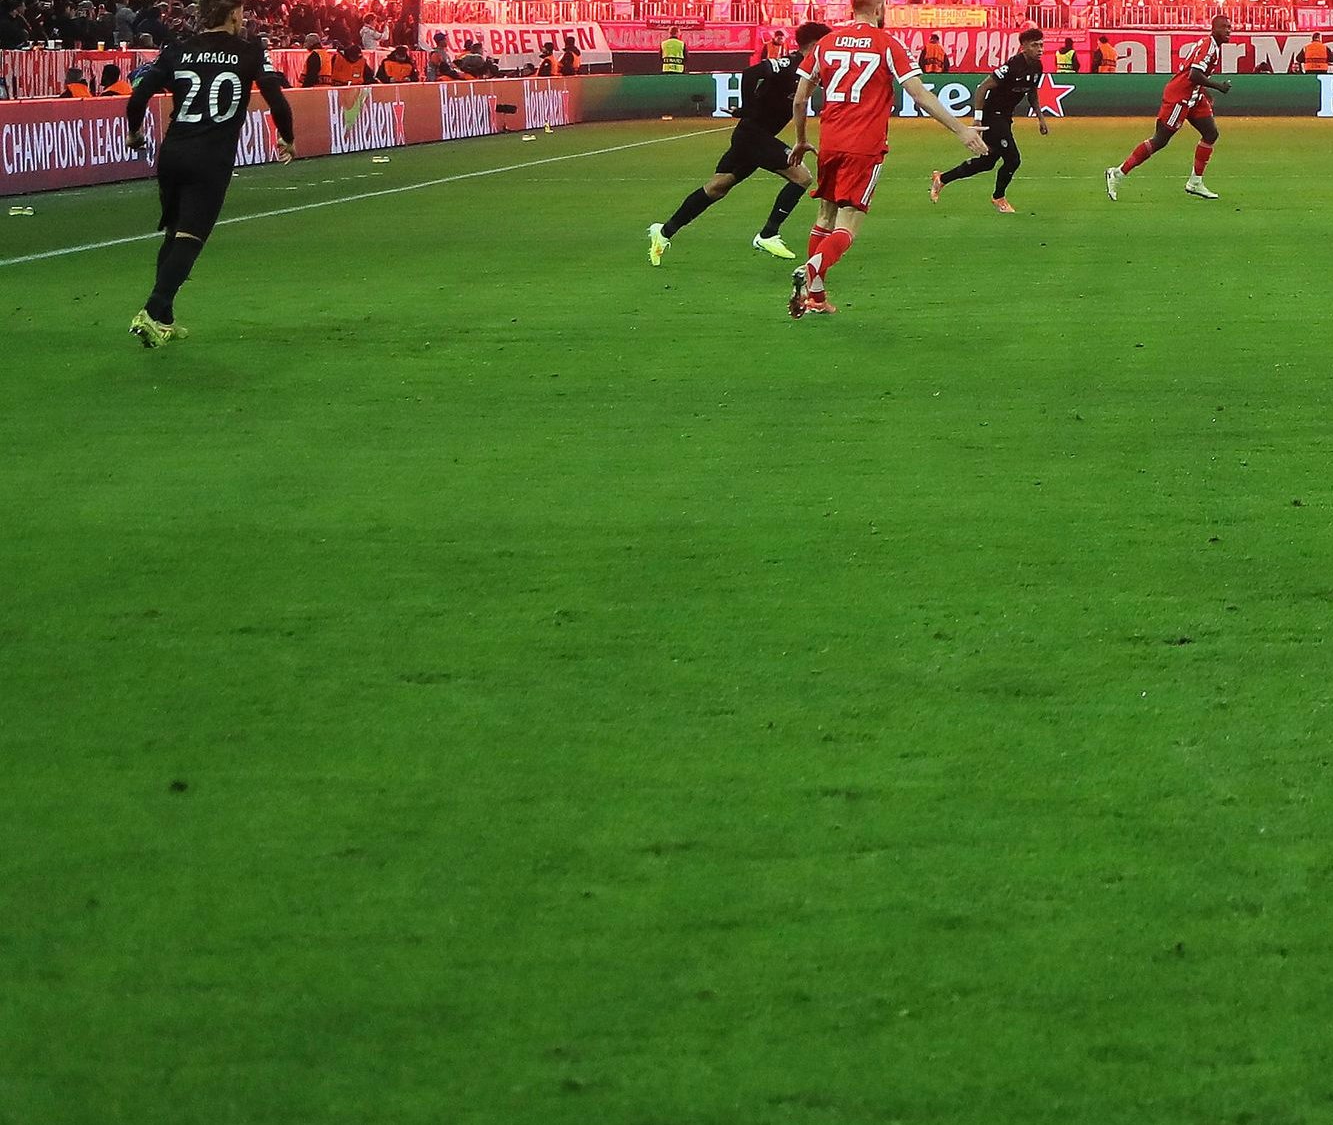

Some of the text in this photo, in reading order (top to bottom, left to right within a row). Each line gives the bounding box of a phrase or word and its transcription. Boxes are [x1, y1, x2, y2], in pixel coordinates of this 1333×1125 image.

[181, 51, 239, 65] M. ARAÚJO
[490, 26, 596, 55] BRETTEN
[835, 36, 872, 49] LAIMER
[824, 50, 881, 83] 27
[174, 70, 243, 123] 20
[439, 83, 489, 141] Heineken
[523, 79, 564, 130] Heineken
[3, 115, 138, 175] CHAMPIONS LEAGU
